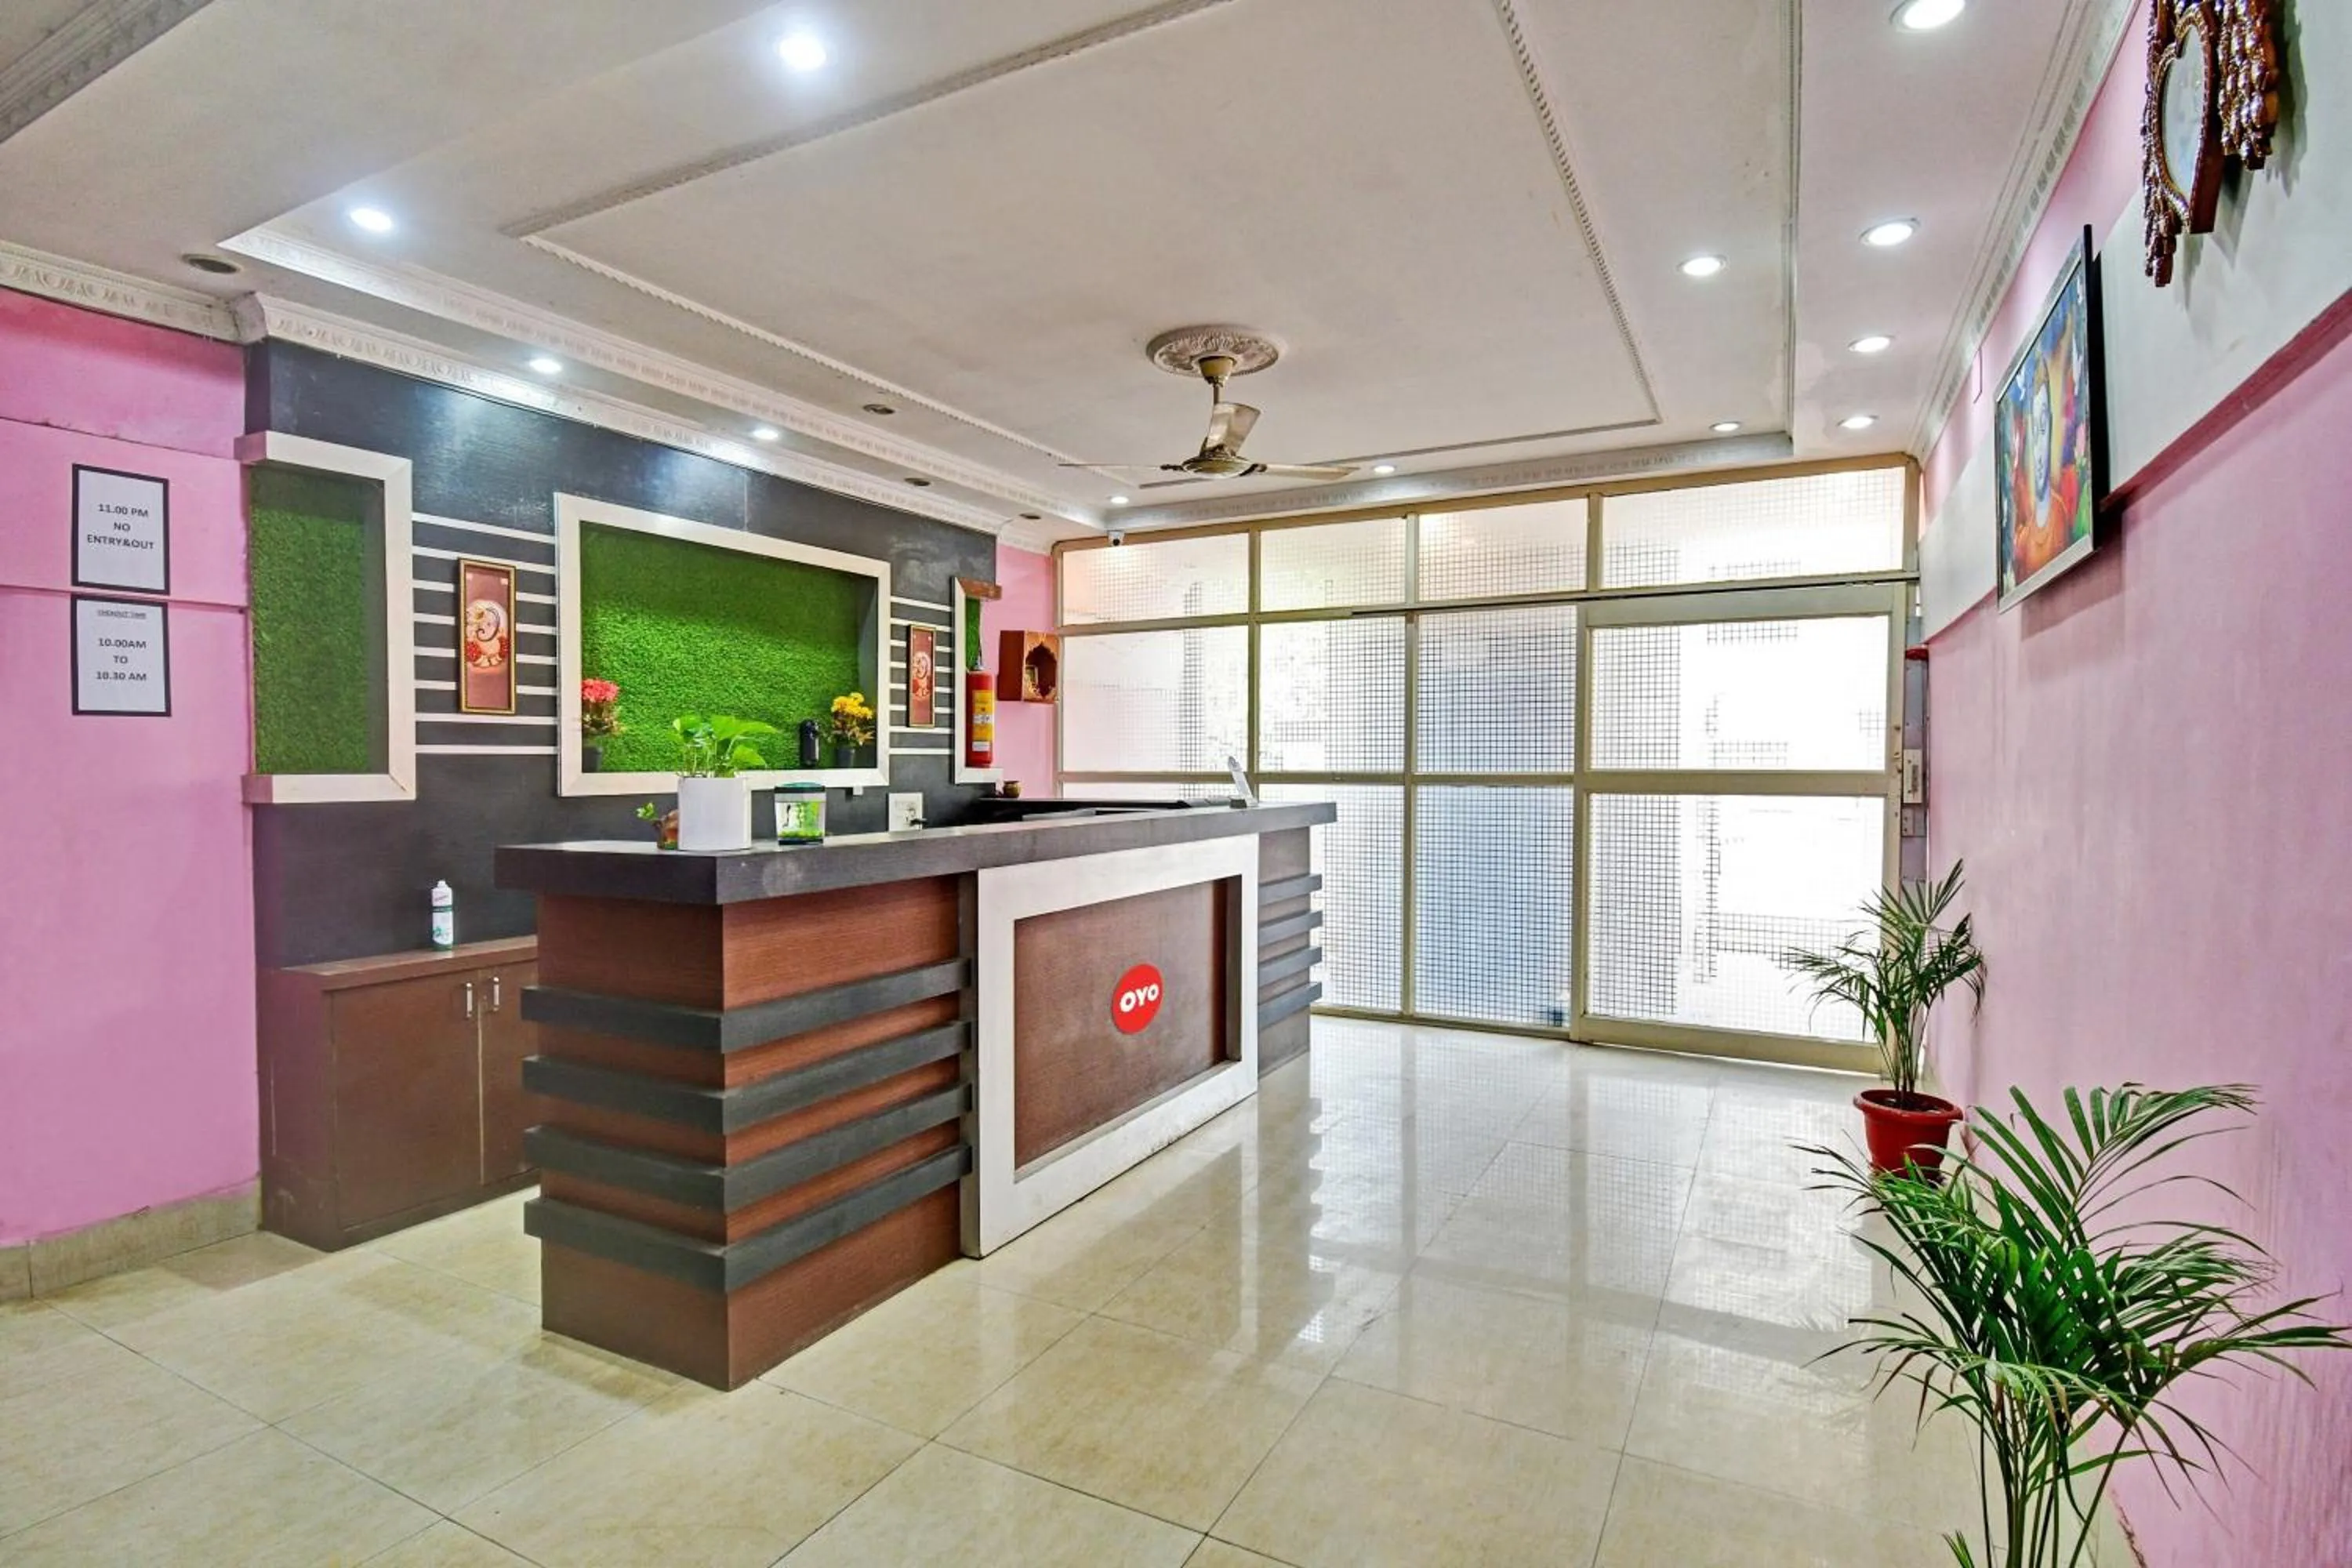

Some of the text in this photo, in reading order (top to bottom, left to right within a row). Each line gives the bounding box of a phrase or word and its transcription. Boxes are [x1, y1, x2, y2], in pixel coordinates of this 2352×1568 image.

[98, 503, 148, 517] 11.00 PM
[114, 522, 131, 532] NO
[87, 534, 154, 550] ENTRY&OUT
[99, 638, 147, 649] 10.00AM
[113, 655, 128, 664] TO
[128, 673, 147, 681] AM
[1120, 983, 1159, 1012] OYO
